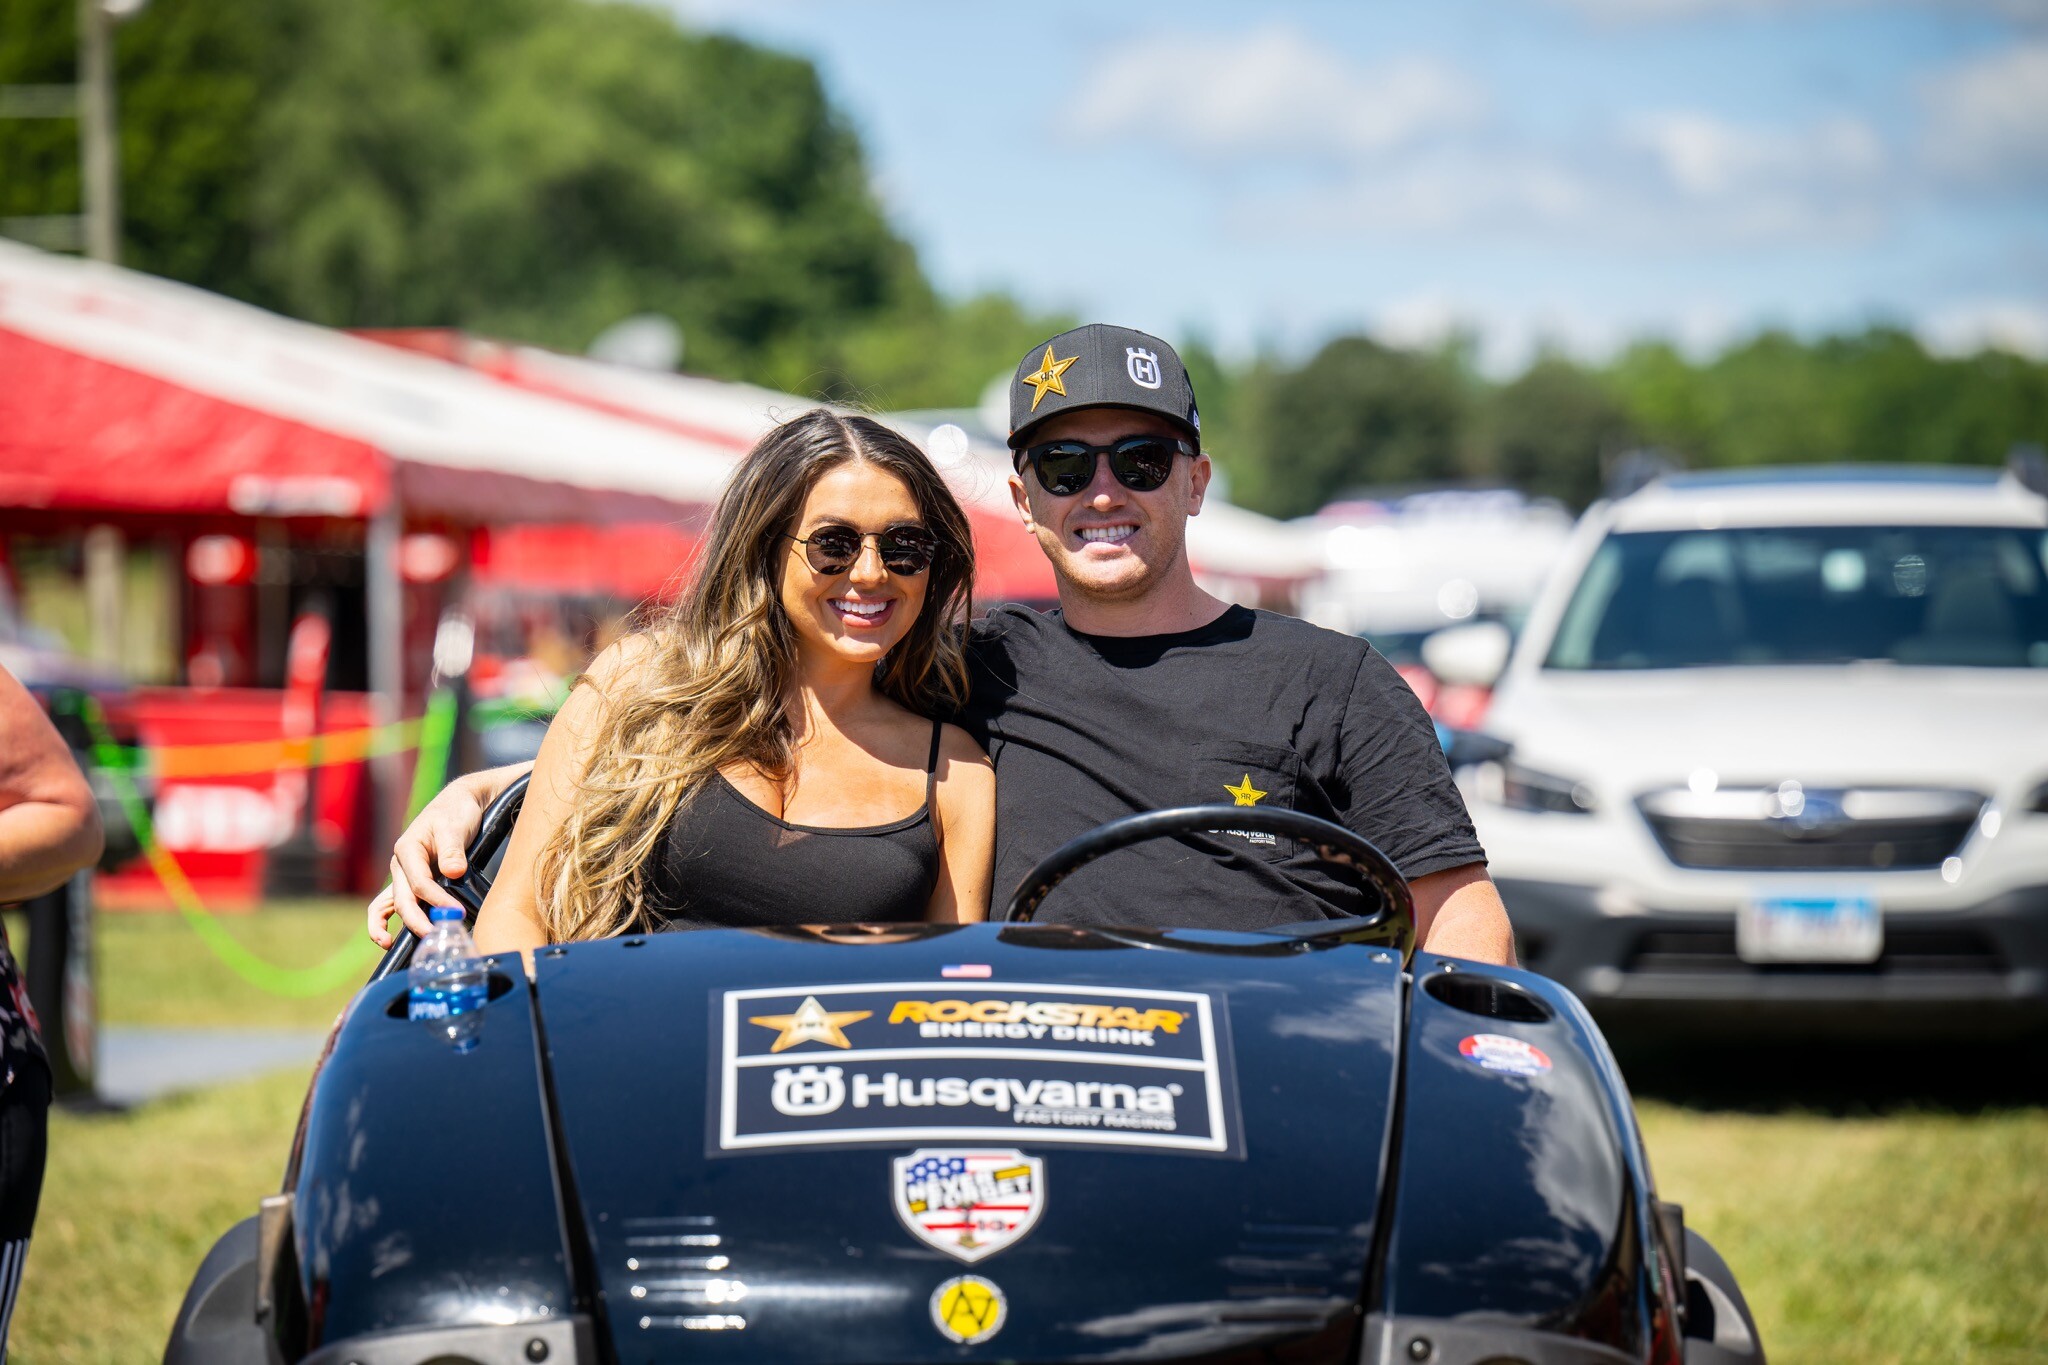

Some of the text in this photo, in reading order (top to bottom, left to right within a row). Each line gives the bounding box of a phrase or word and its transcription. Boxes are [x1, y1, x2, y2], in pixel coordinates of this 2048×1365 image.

[888, 1000, 1185, 1033] ROCKSTAR
[919, 1021, 1155, 1046] ENERGY DRINK
[852, 1073, 1176, 1112] Husqvarna
[1013, 1110, 1177, 1131] FACTORY RACING
